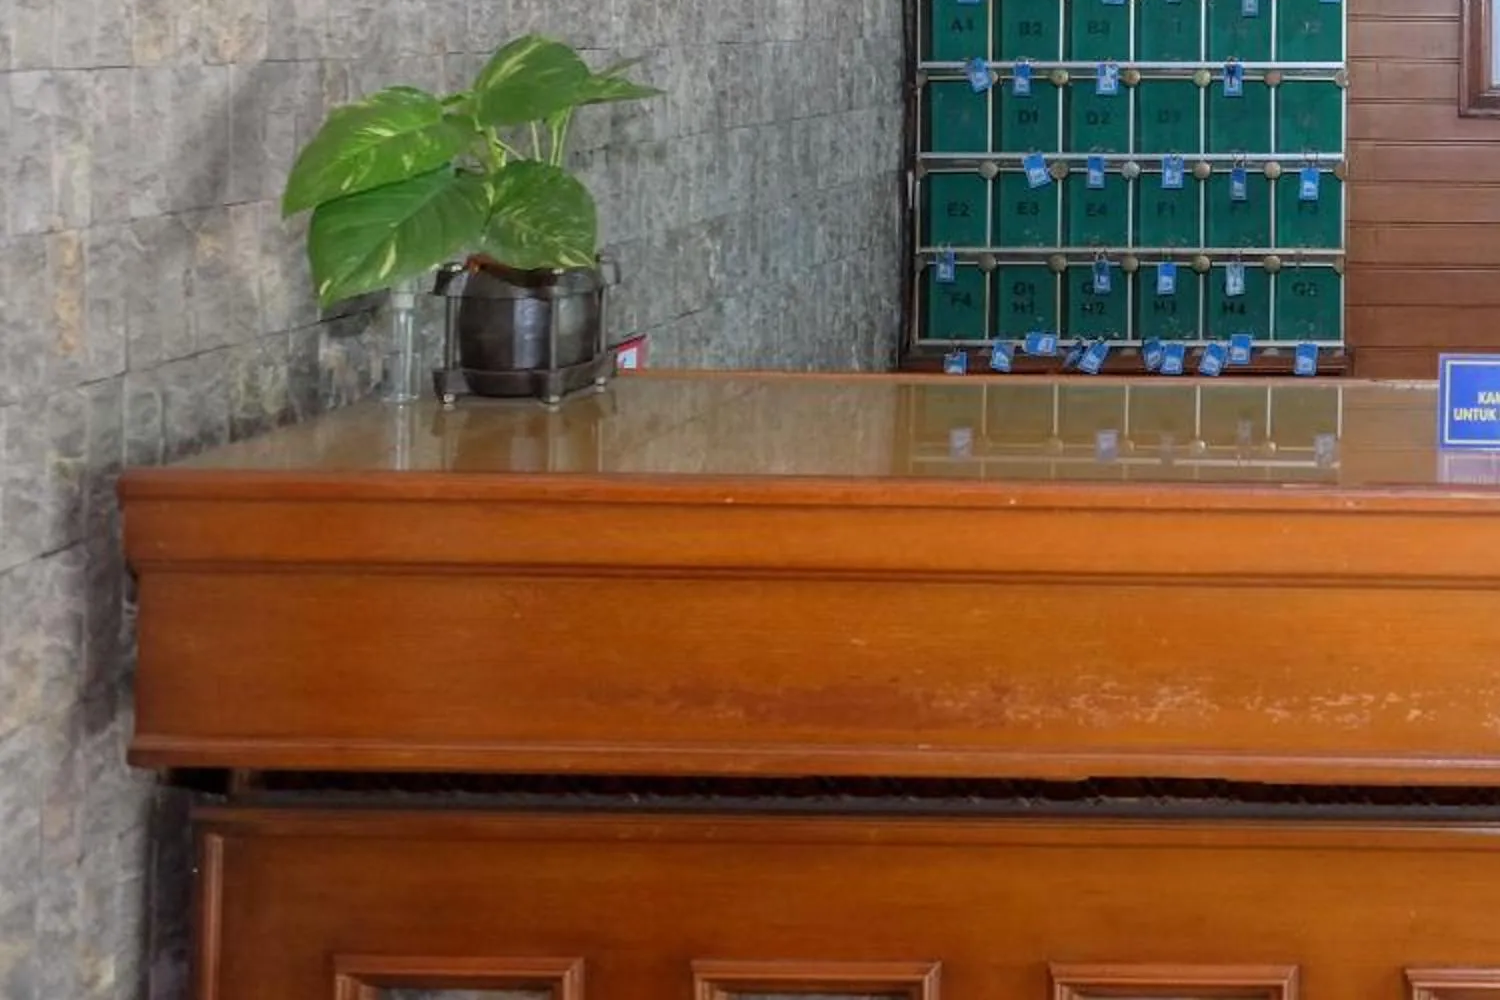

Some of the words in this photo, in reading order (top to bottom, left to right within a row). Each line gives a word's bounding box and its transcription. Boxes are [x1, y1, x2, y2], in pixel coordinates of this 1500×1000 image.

[1017, 109, 1039, 124] D1
[946, 202, 971, 217] E2
[1453, 407, 1497, 421] UNTUK
